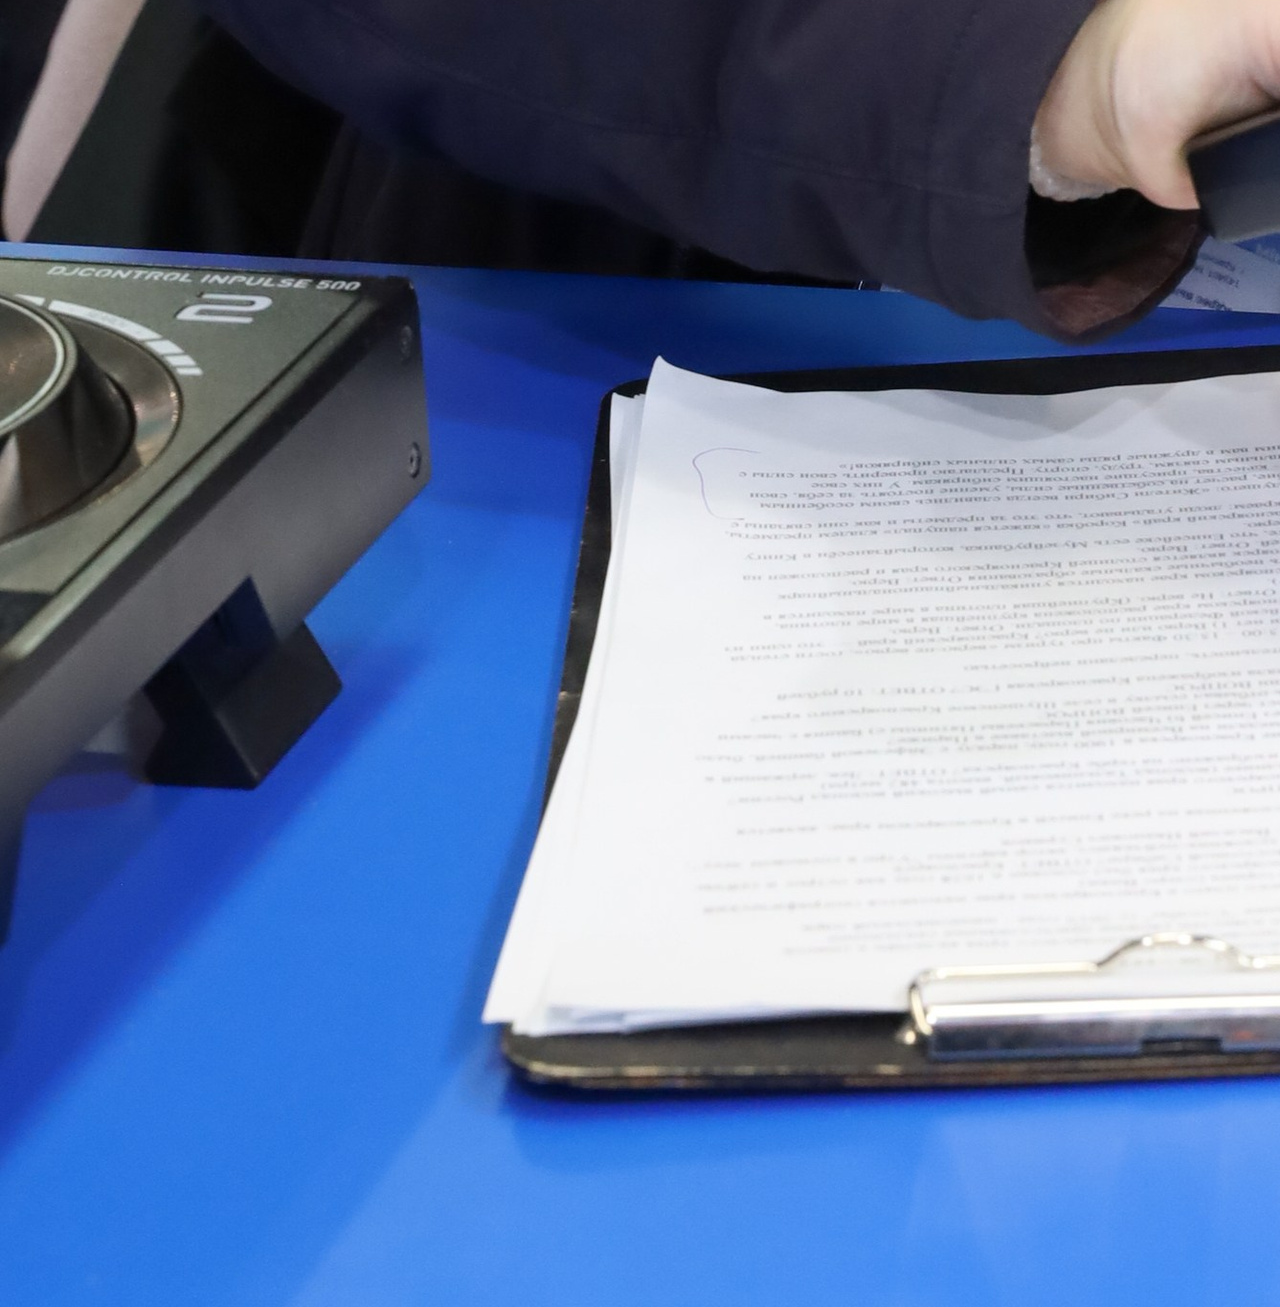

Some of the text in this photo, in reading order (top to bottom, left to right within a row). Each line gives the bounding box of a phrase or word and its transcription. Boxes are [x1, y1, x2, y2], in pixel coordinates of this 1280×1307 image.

[47, 266, 361, 291] DJCONTROL INPULSE 500
[175, 292, 273, 324] 2
